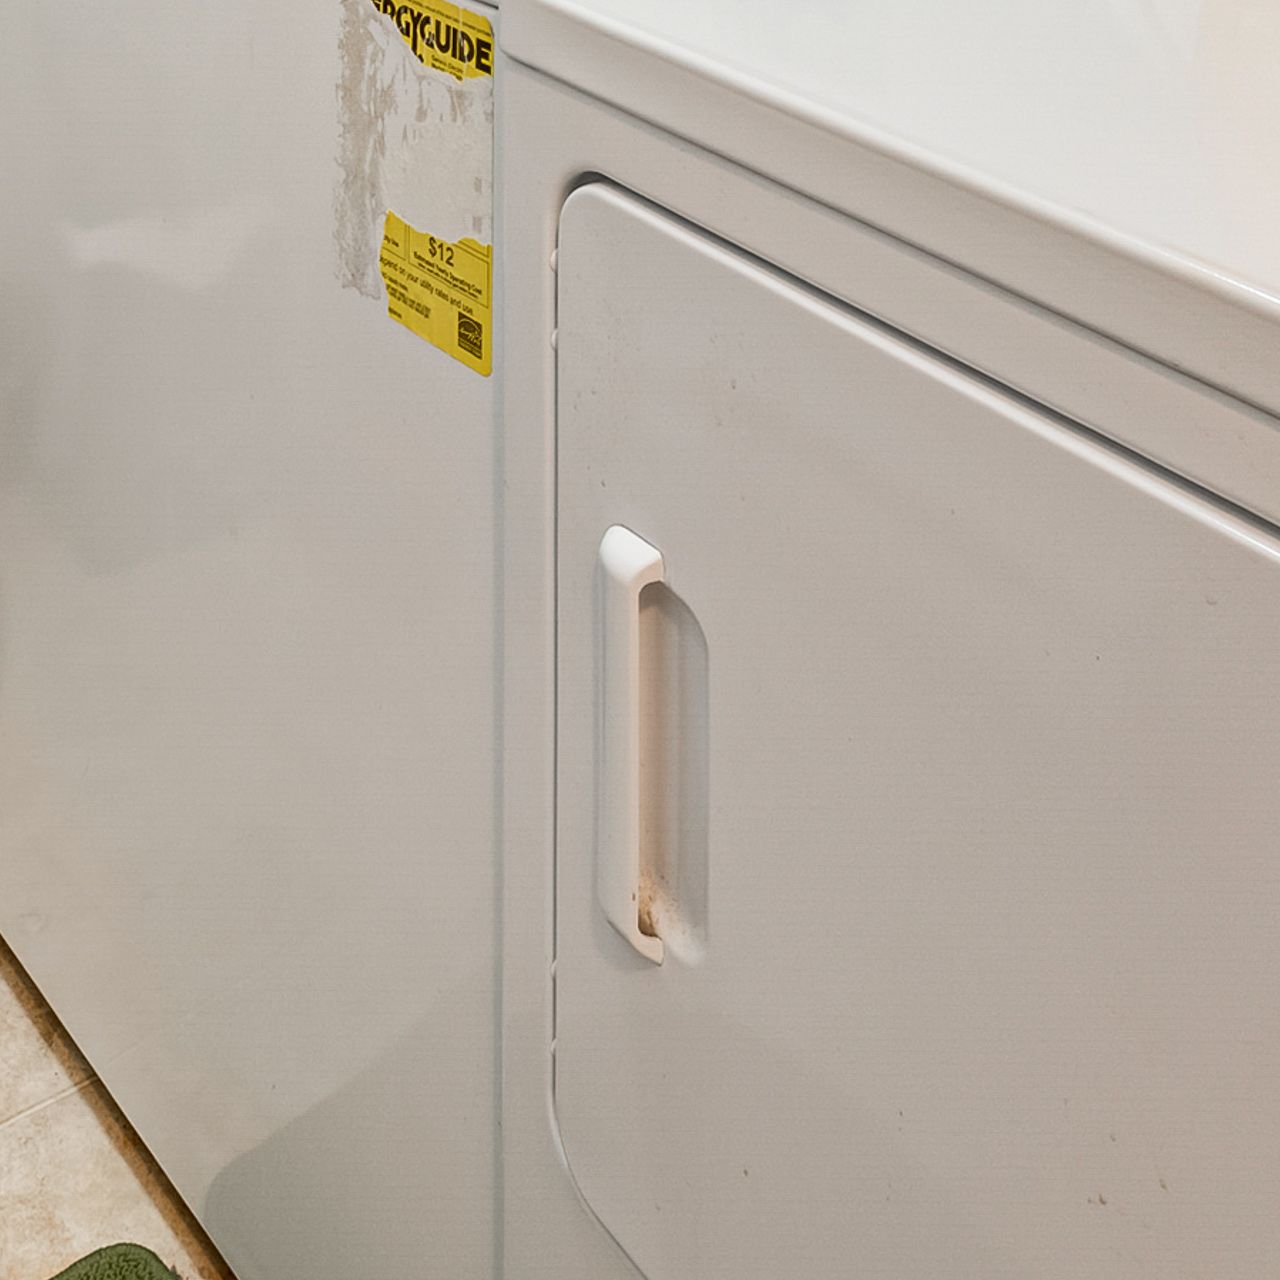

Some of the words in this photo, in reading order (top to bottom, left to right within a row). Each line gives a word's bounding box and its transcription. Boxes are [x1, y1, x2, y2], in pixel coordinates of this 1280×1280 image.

[428, 236, 454, 268] $12
[406, 271, 419, 283] your
[435, 287, 449, 302] rates
[450, 296, 462, 309] and
